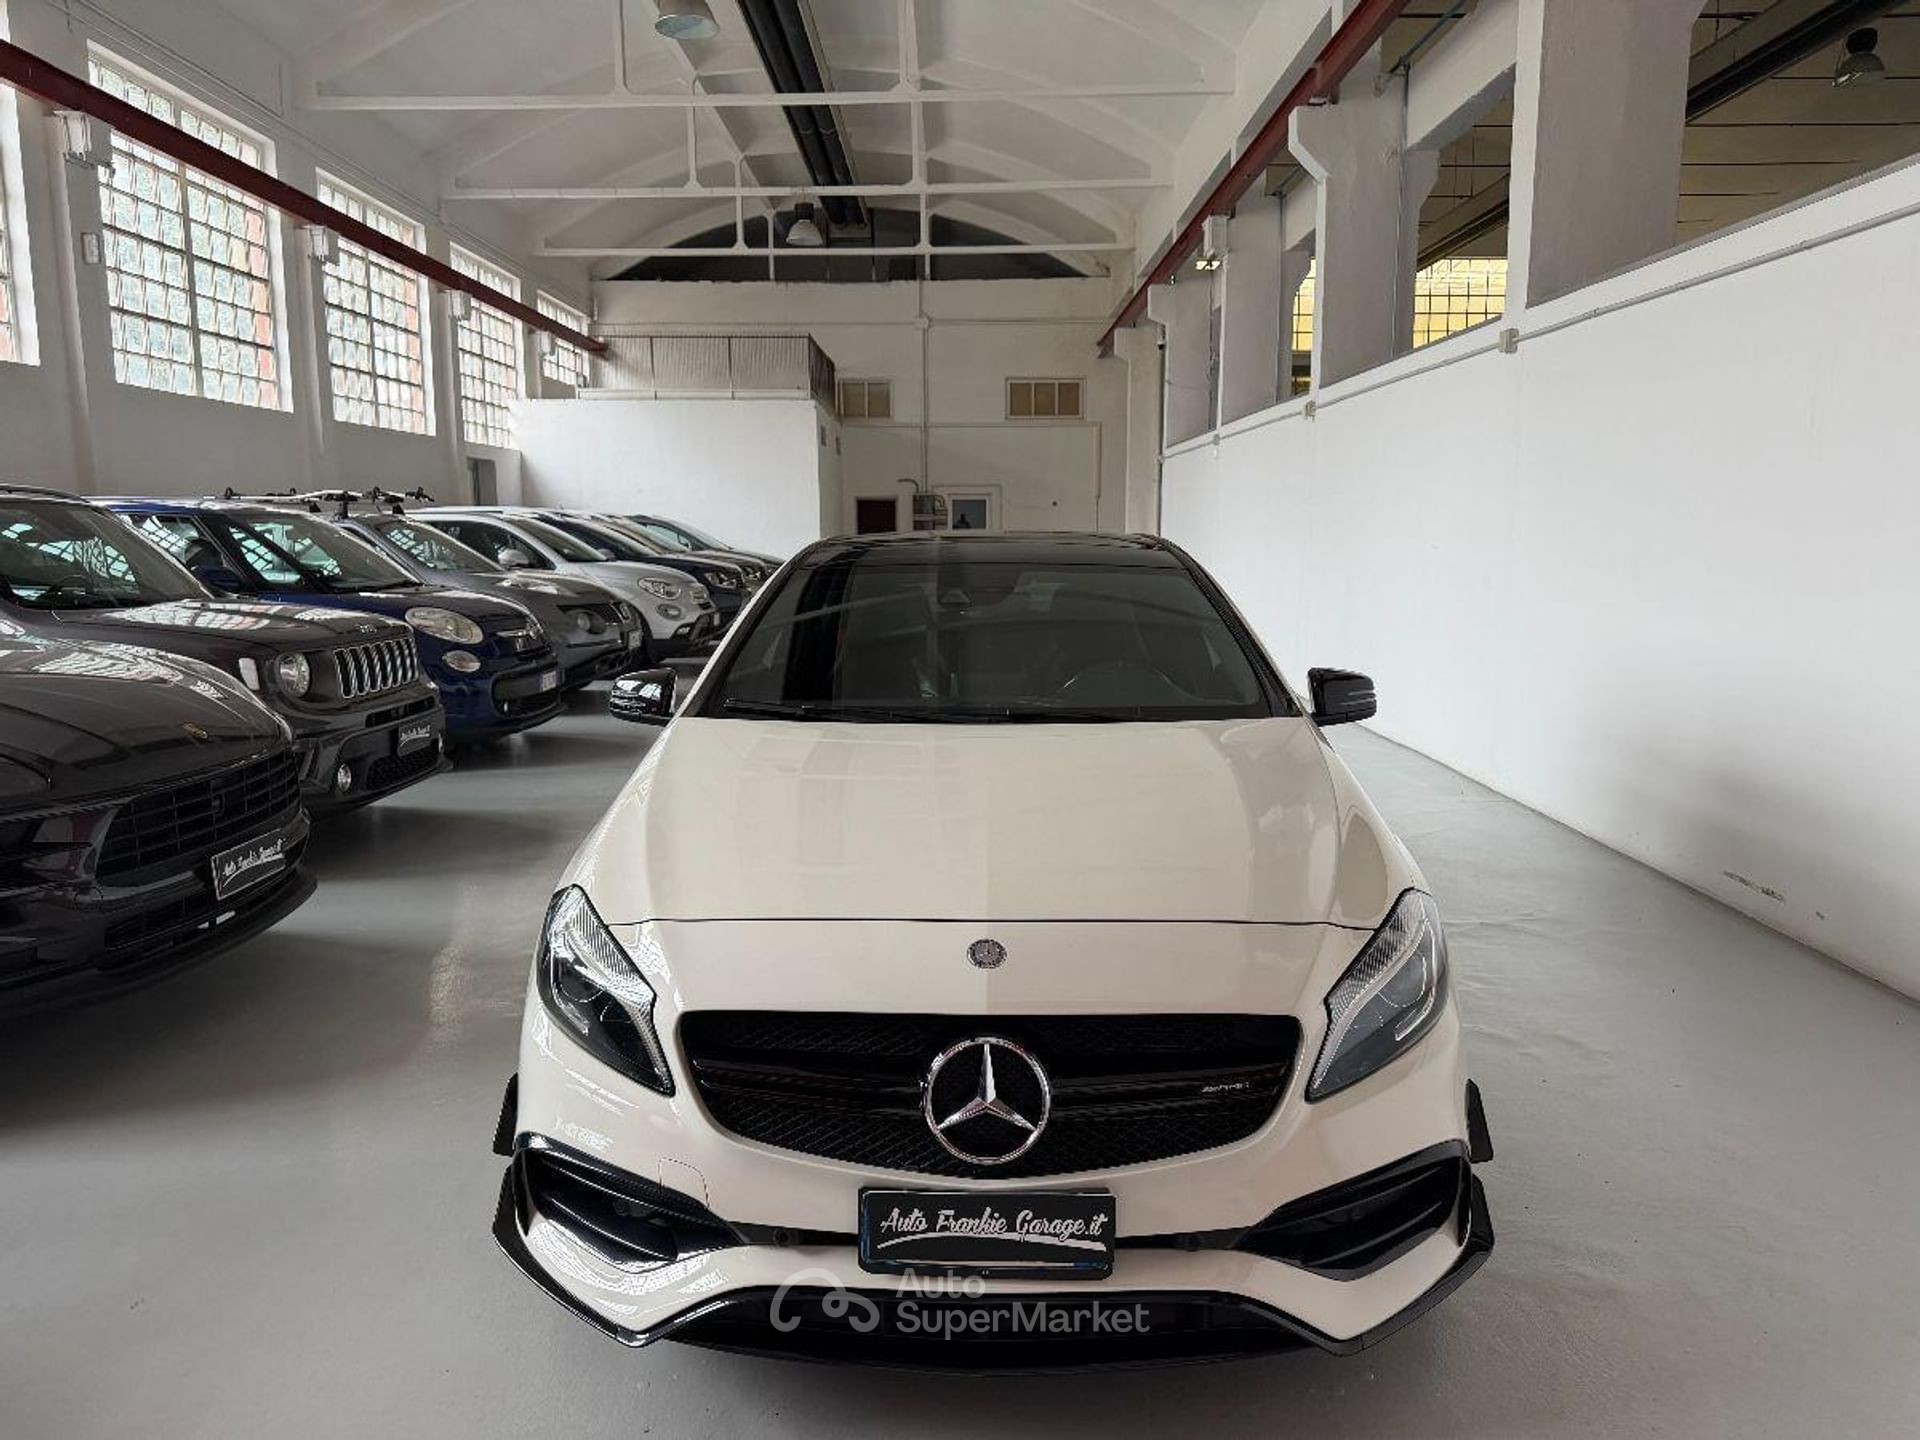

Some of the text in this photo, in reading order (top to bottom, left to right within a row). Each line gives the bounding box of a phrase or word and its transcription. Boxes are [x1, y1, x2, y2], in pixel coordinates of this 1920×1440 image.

[880, 1206, 1109, 1241] Auto Frankie Garage.it
